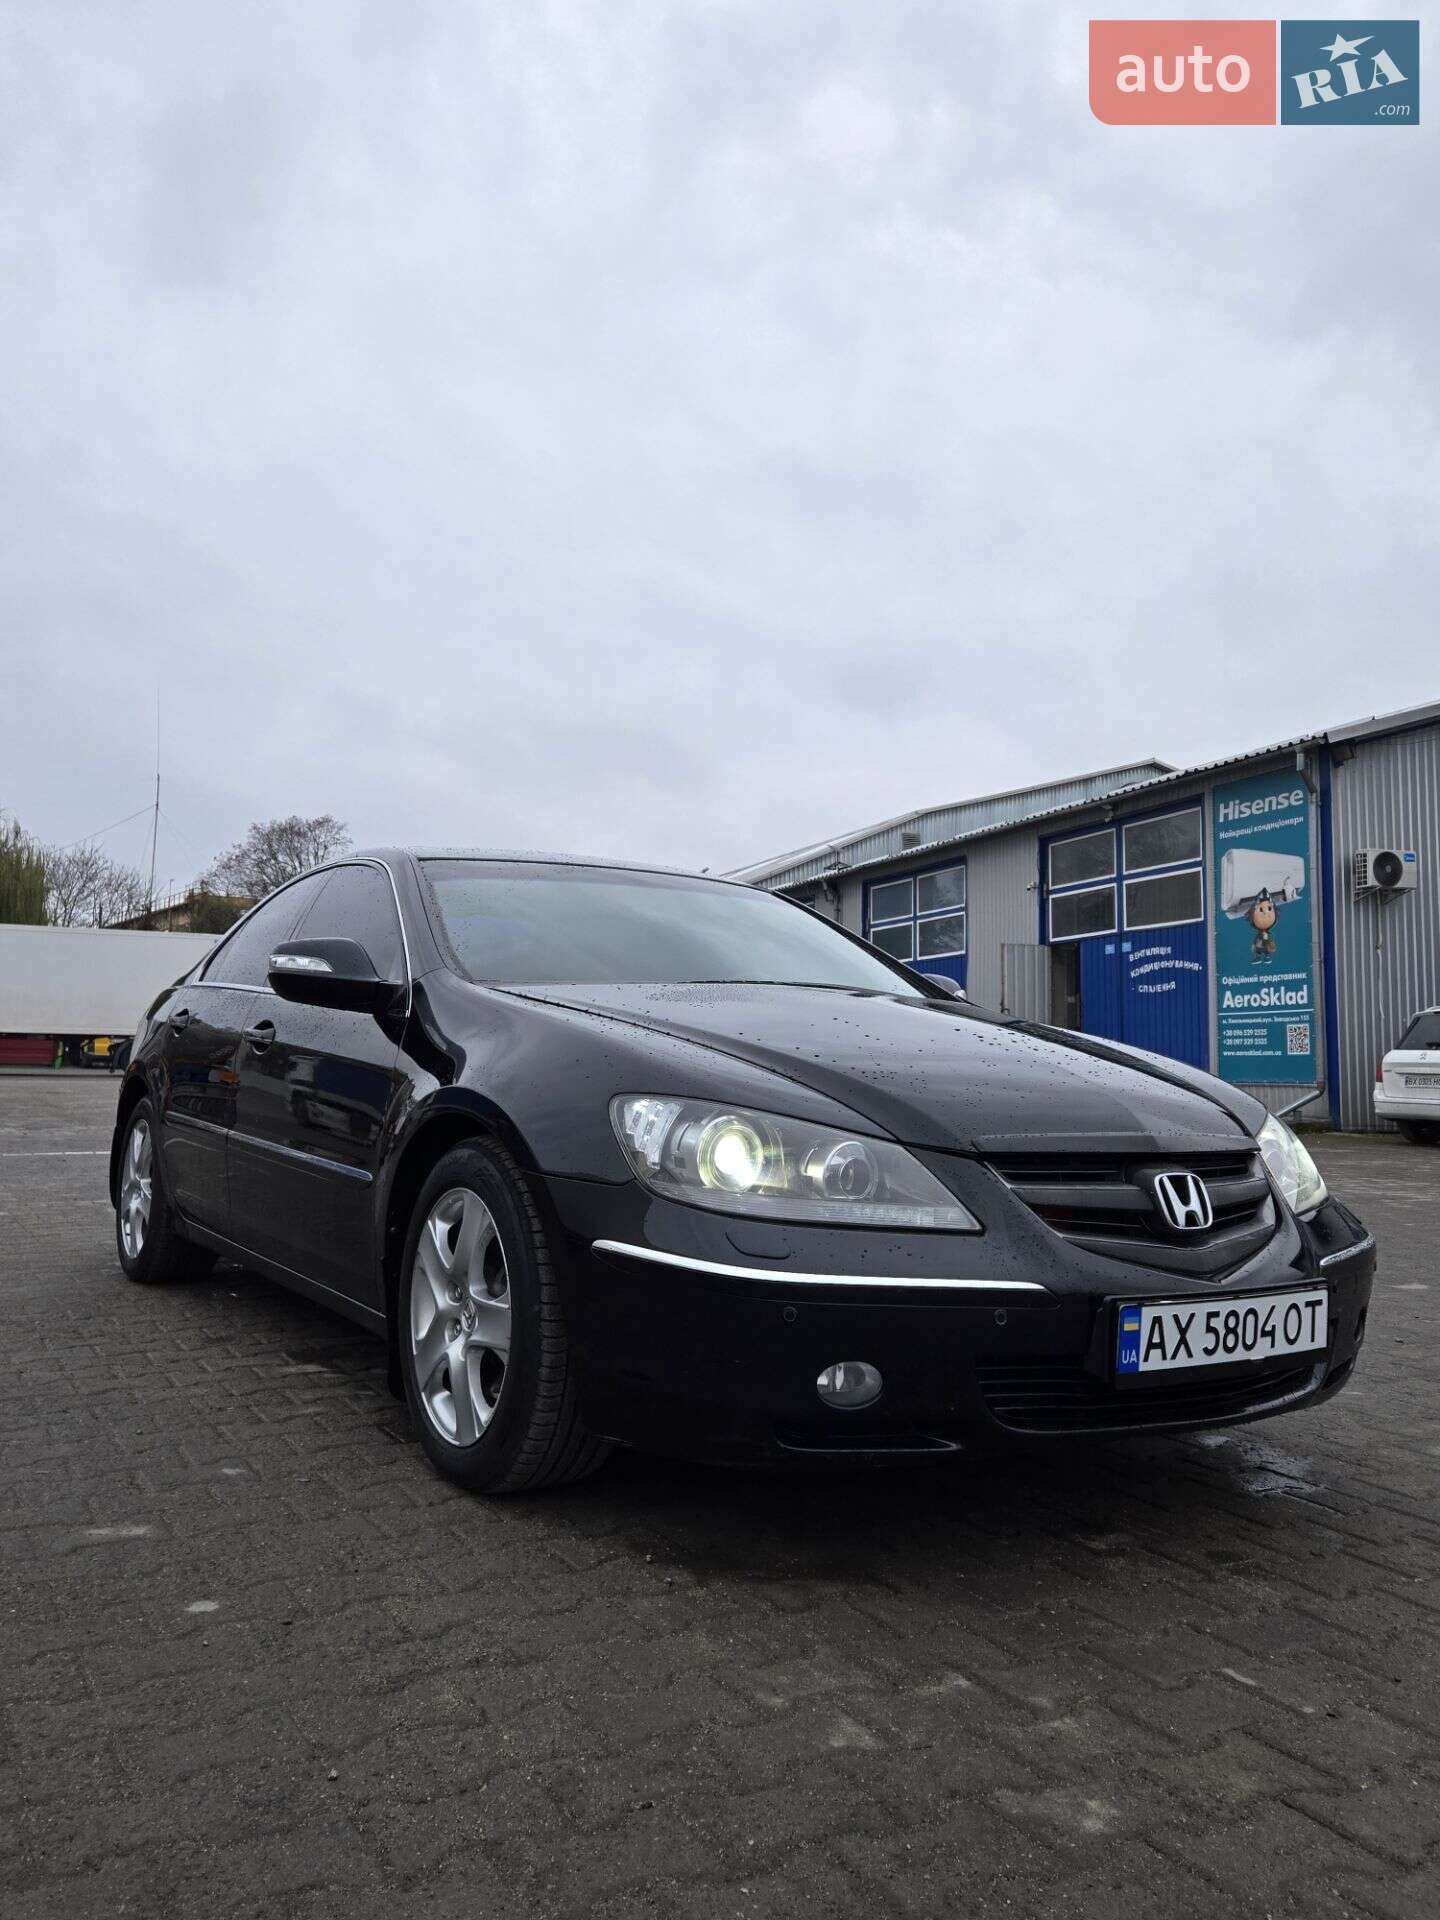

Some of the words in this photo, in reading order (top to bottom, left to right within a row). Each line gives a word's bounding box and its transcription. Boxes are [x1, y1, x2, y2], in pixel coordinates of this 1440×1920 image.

[1219, 789, 1304, 823] Hisense
[1222, 984, 1308, 1009] AeroSklad
[1143, 1311, 1196, 1363] AX
[1202, 1305, 1277, 1357] 5804
[1283, 1298, 1324, 1346] OT
[1121, 1349, 1138, 1364] UA
